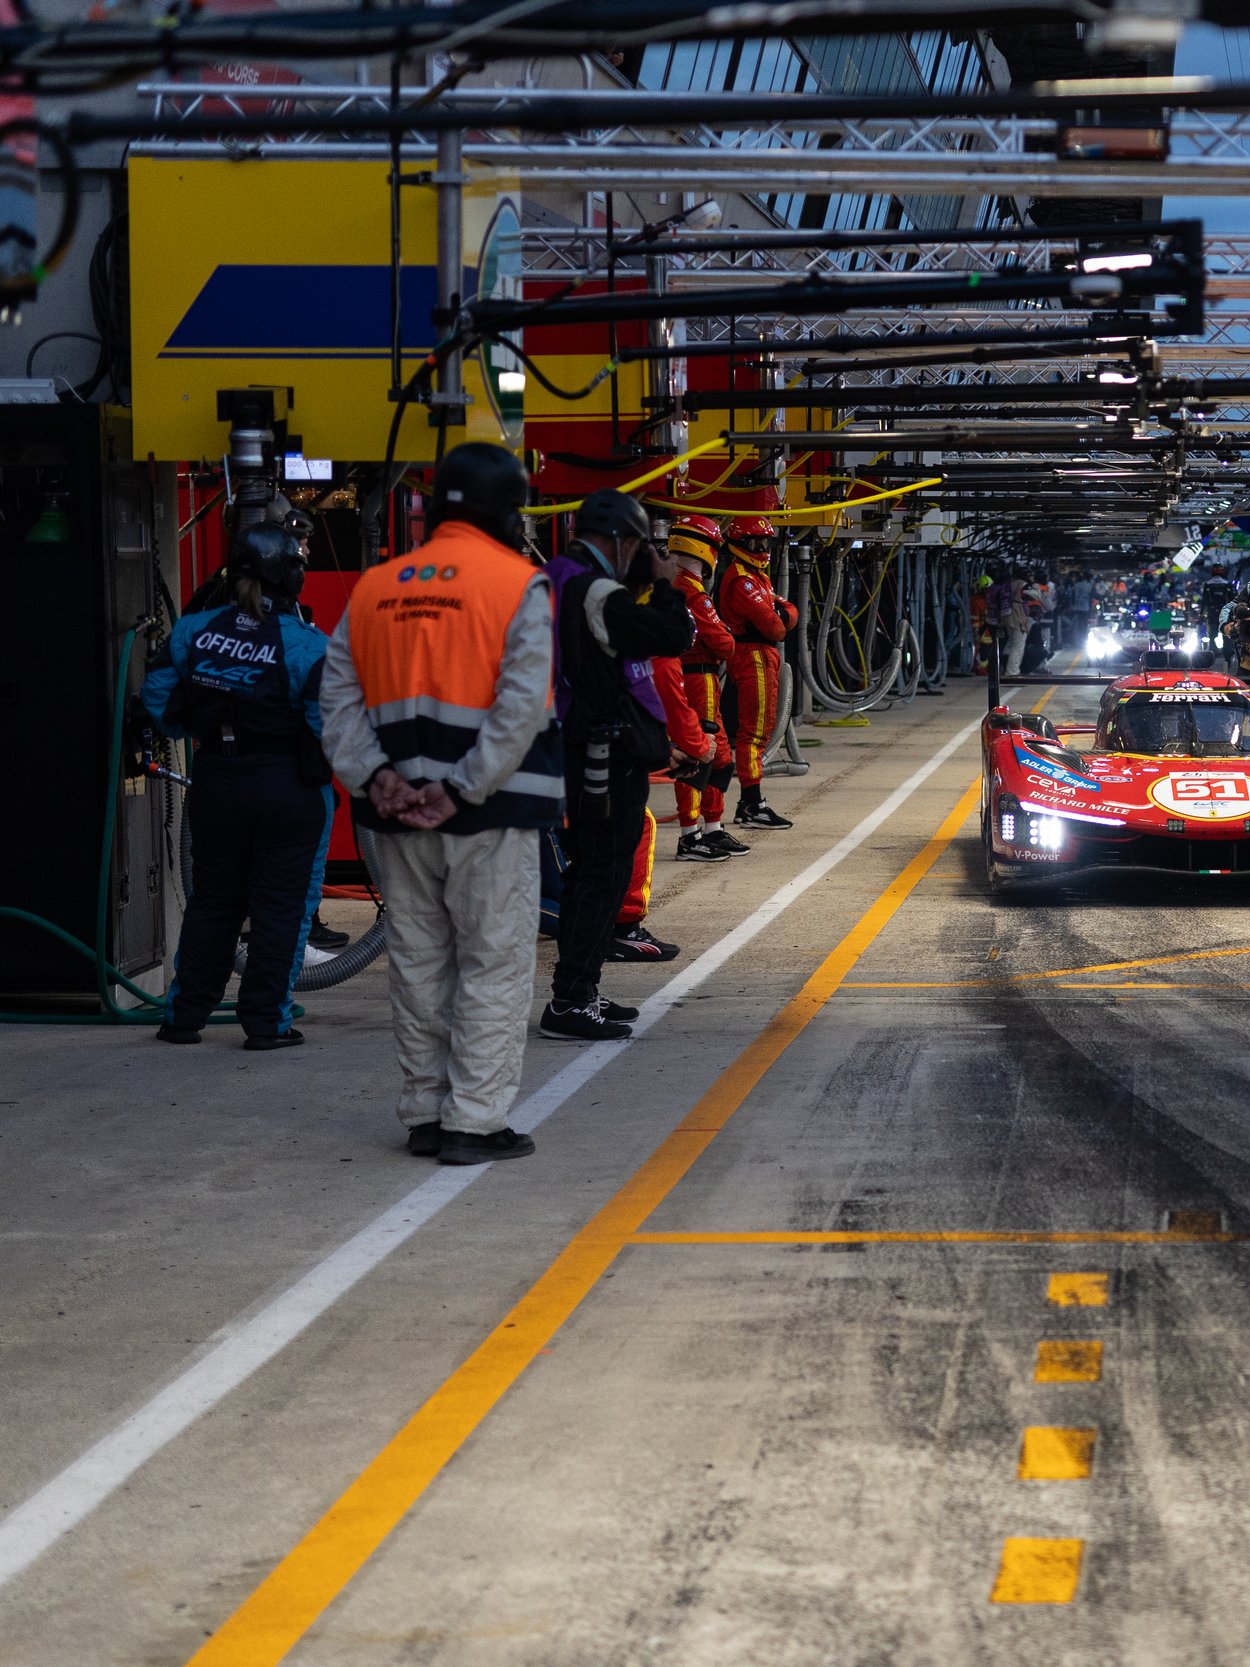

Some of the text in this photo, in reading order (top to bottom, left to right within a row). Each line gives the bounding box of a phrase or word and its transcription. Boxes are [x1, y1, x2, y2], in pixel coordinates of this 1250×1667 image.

[1184, 525, 1202, 541] 12
[400, 596, 462, 611] MARSHAL
[195, 632, 278, 664] OFFICIAL
[194, 659, 265, 684] WEC
[1149, 692, 1232, 703] Ferrari
[1020, 758, 1097, 790] ADLER GROUP
[1176, 780, 1245, 798] 51
[1029, 791, 1131, 815] RICHARD MILLE
[1014, 850, 1060, 861] V-Power
